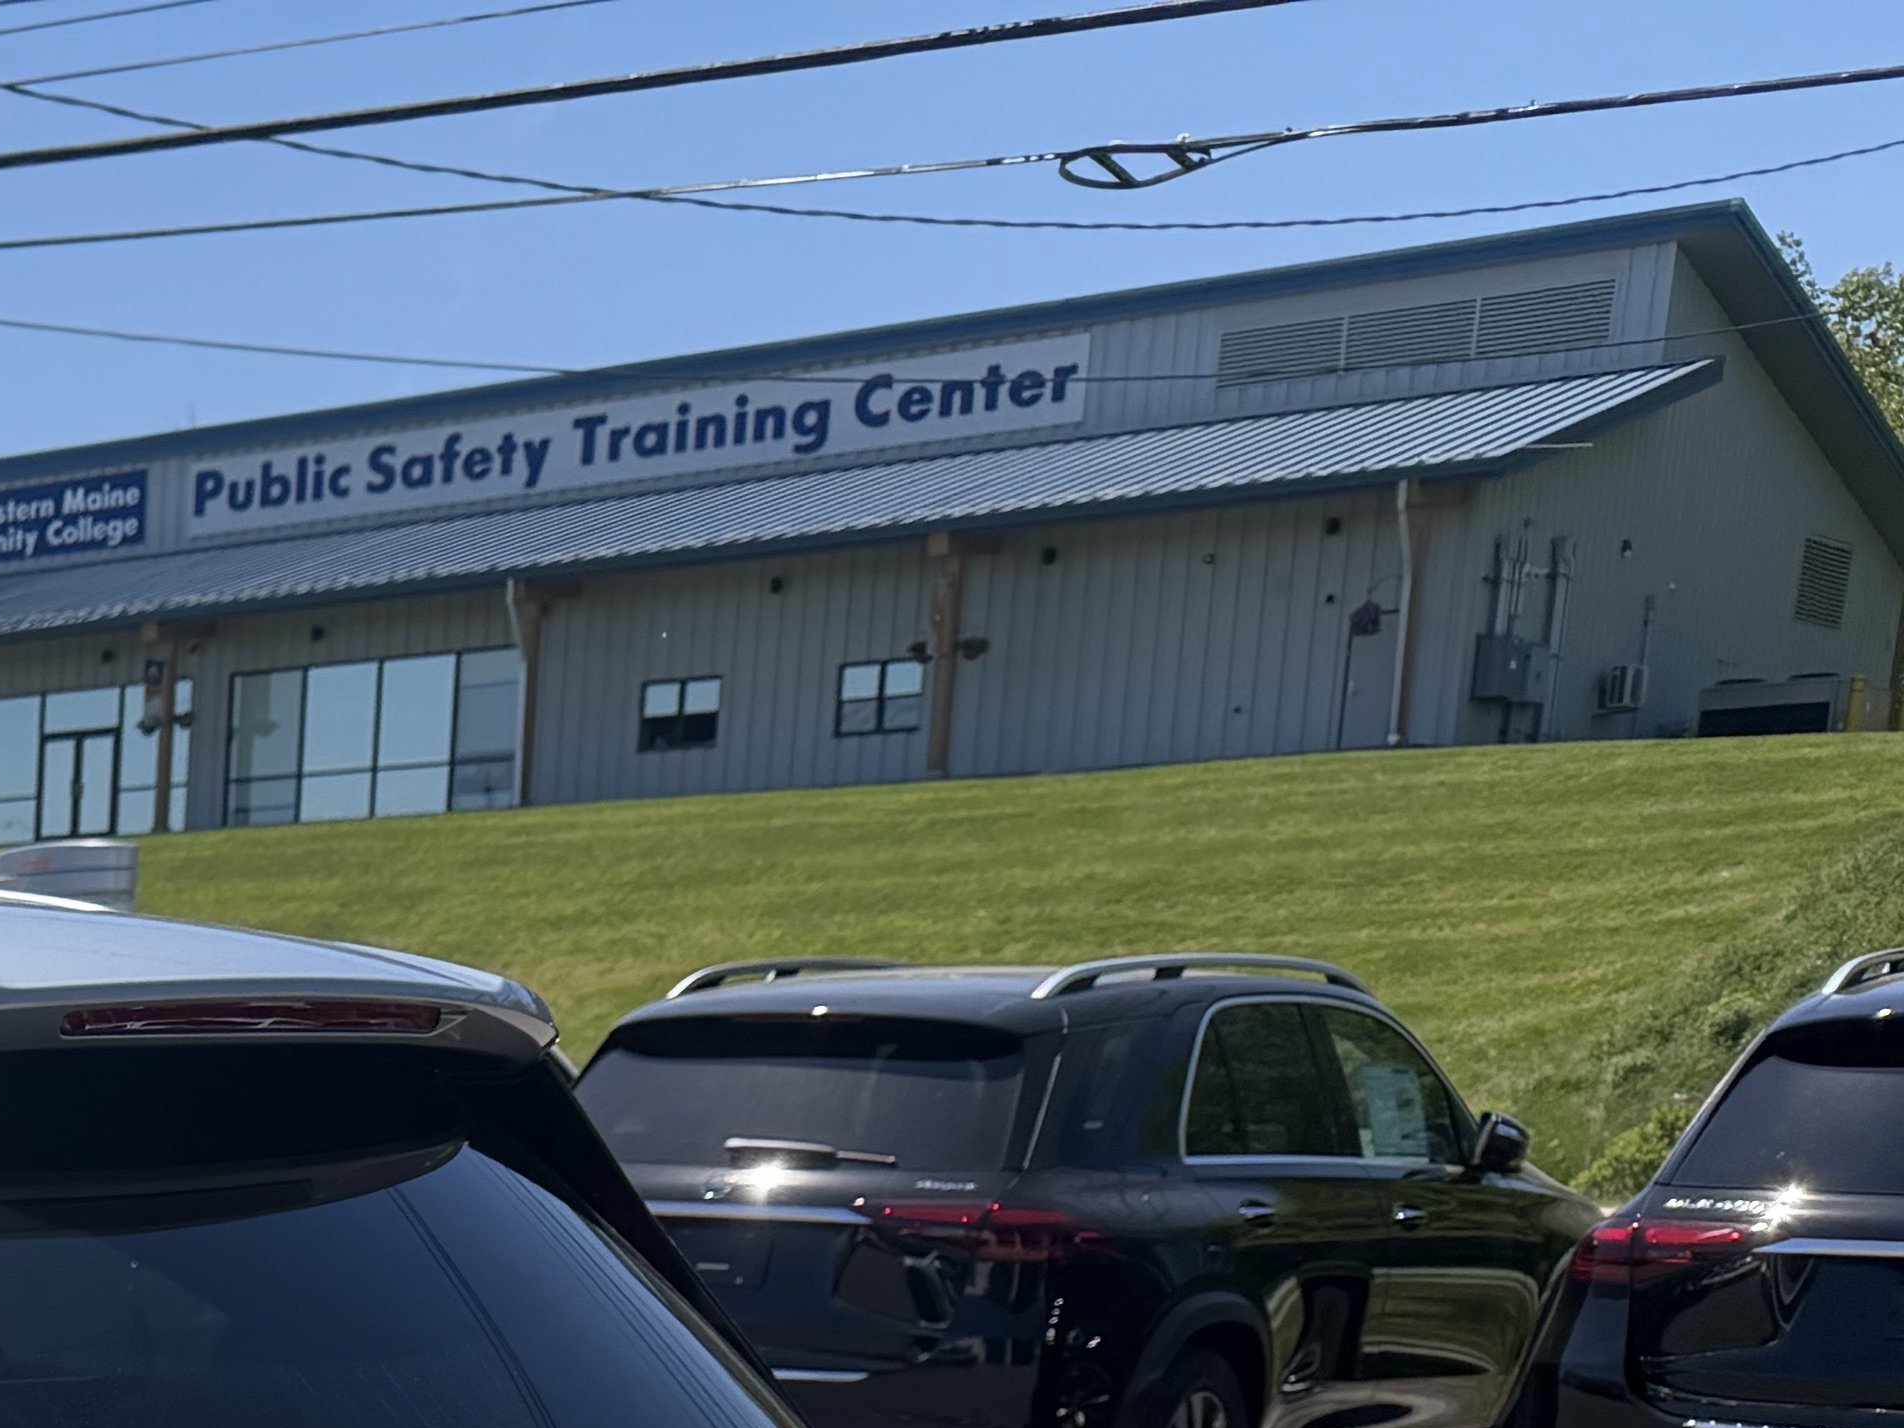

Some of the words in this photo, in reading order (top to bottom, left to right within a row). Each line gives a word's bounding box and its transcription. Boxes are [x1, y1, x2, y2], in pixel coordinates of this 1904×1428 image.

[193, 451, 352, 518] Public
[365, 431, 552, 495] Safety
[572, 393, 832, 466] Training
[854, 362, 1079, 428] Center
[61, 482, 141, 516] Maine
[45, 514, 140, 547] College
